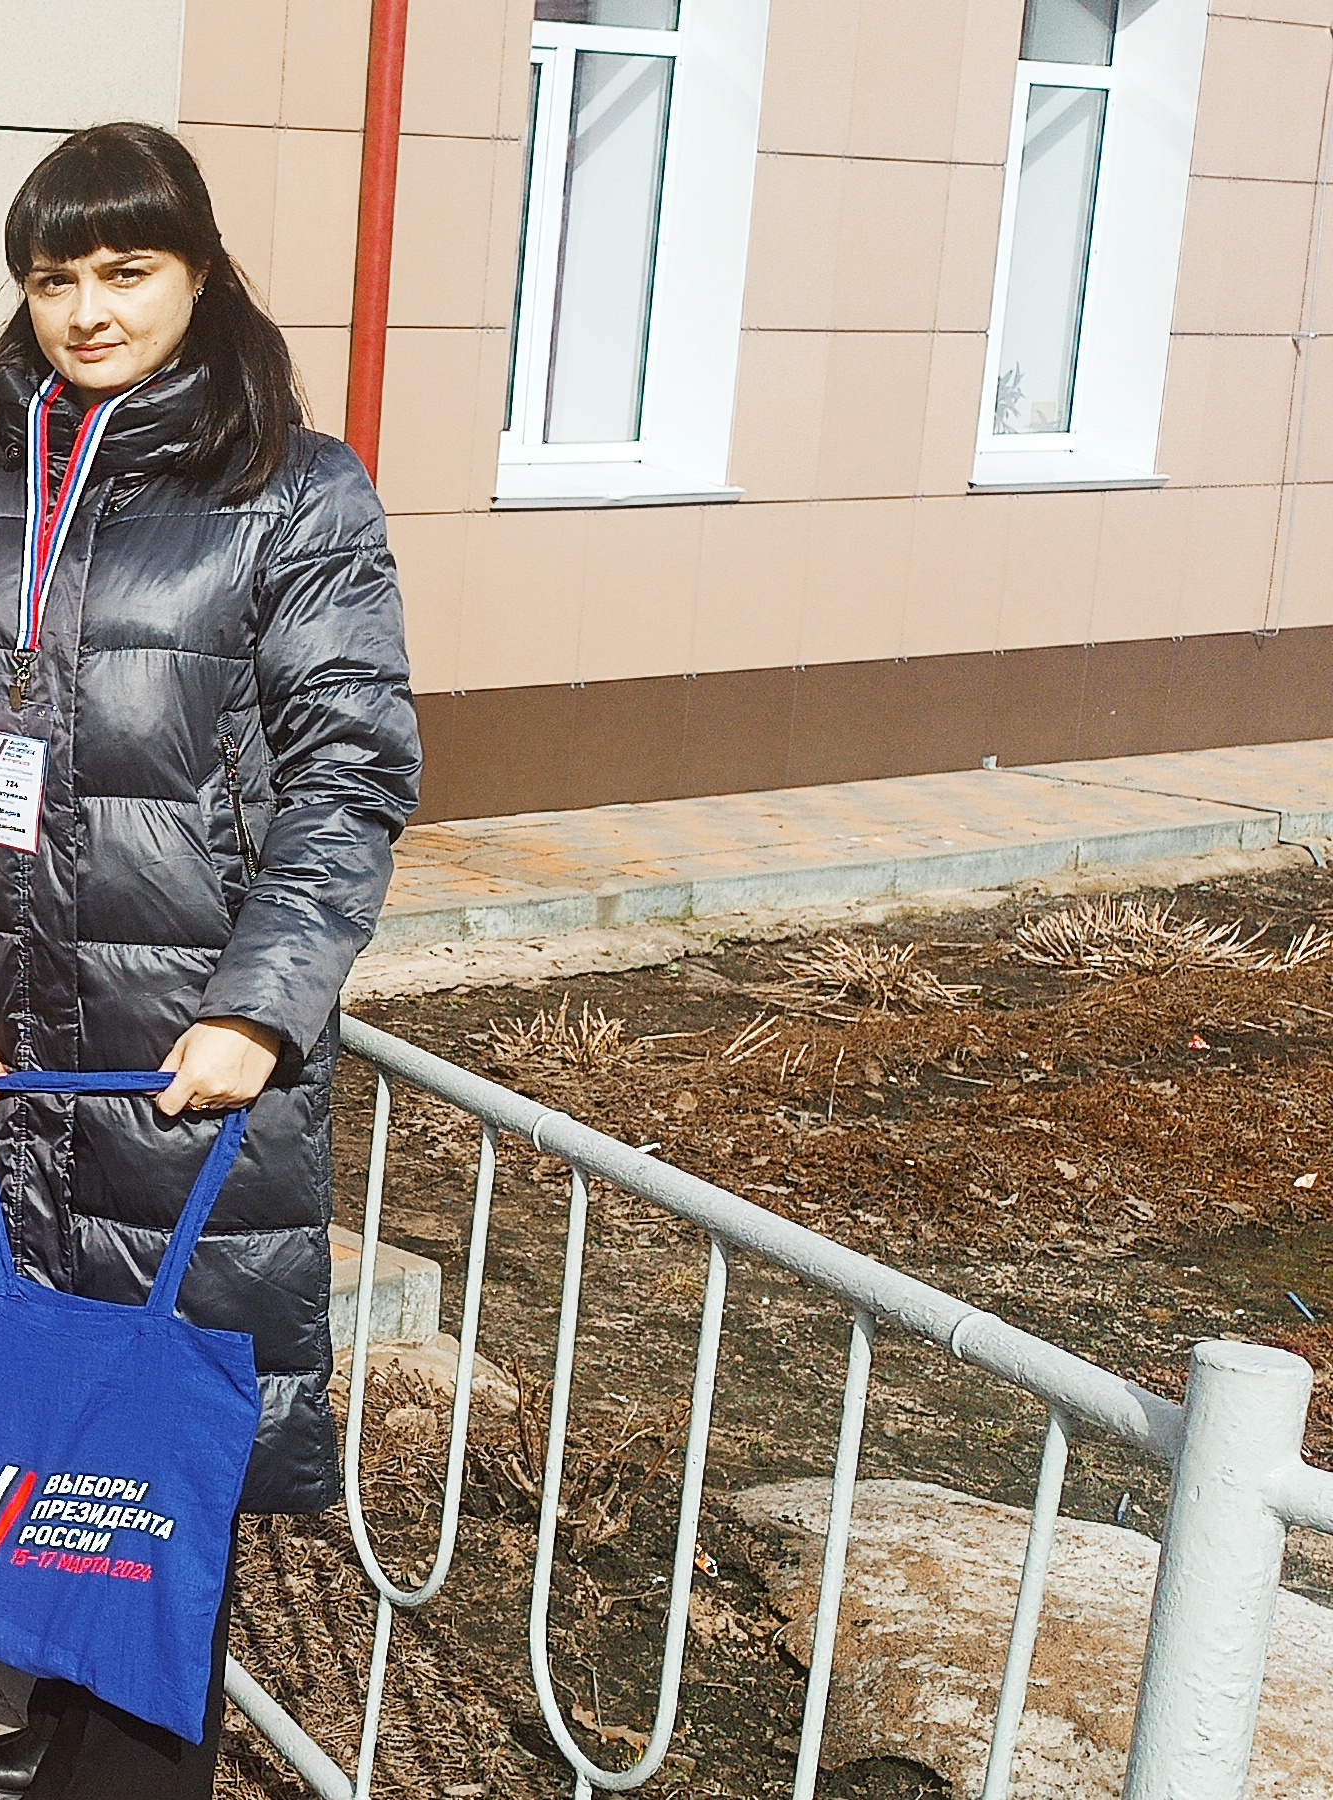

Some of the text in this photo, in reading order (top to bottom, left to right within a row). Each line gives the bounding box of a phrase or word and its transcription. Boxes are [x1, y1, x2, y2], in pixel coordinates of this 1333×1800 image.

[43, 1473, 149, 1502] ВЫБОРЫ
[30, 1499, 176, 1540] ПРЕЗИДЕНТА
[18, 1525, 112, 1553] РОССИИ
[56, 1553, 111, 1576] МАРТА
[110, 1560, 154, 1583] 2024
